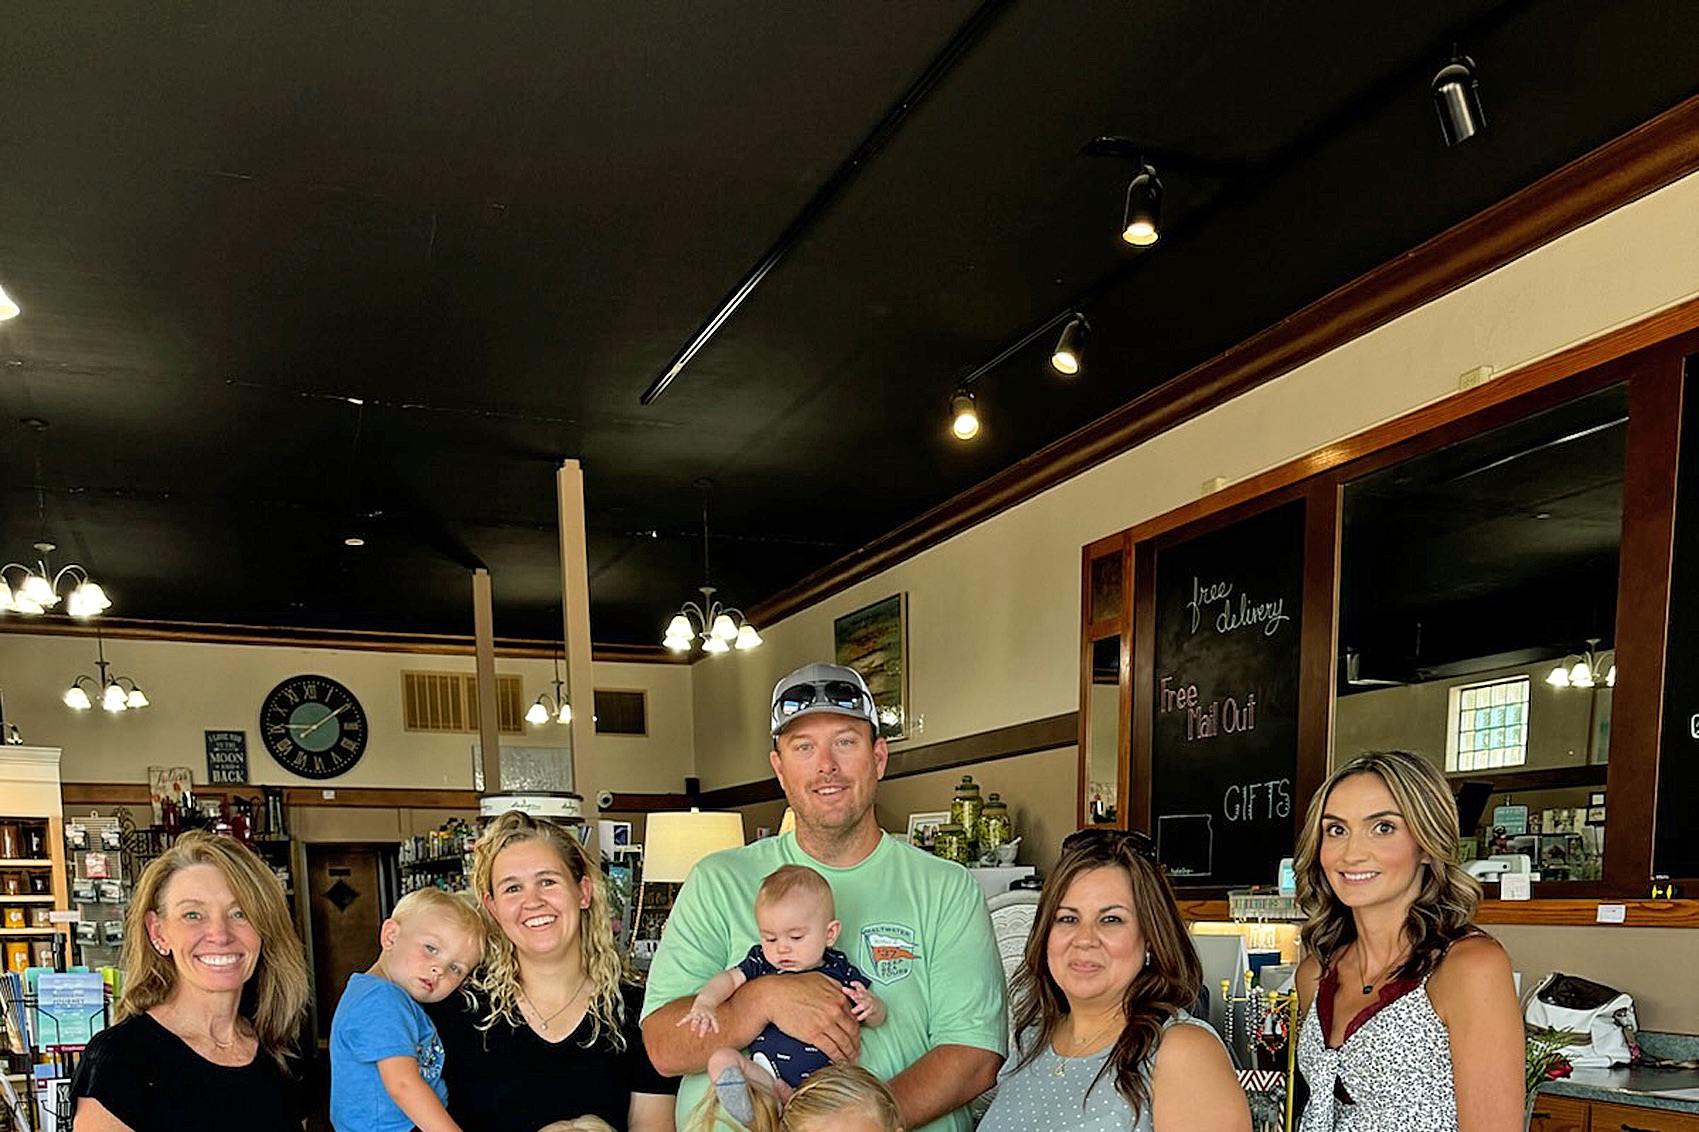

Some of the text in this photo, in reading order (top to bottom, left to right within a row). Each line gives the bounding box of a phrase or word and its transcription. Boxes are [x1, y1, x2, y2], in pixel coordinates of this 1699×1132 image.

[1186, 576, 1233, 634] free
[1215, 592, 1290, 636] delivery
[1160, 676, 1199, 713] Free
[1187, 693, 1256, 741] Mail Out
[209, 752, 244, 763] MOON
[212, 770, 245, 783] BACK
[1223, 778, 1291, 822] GIFTS
